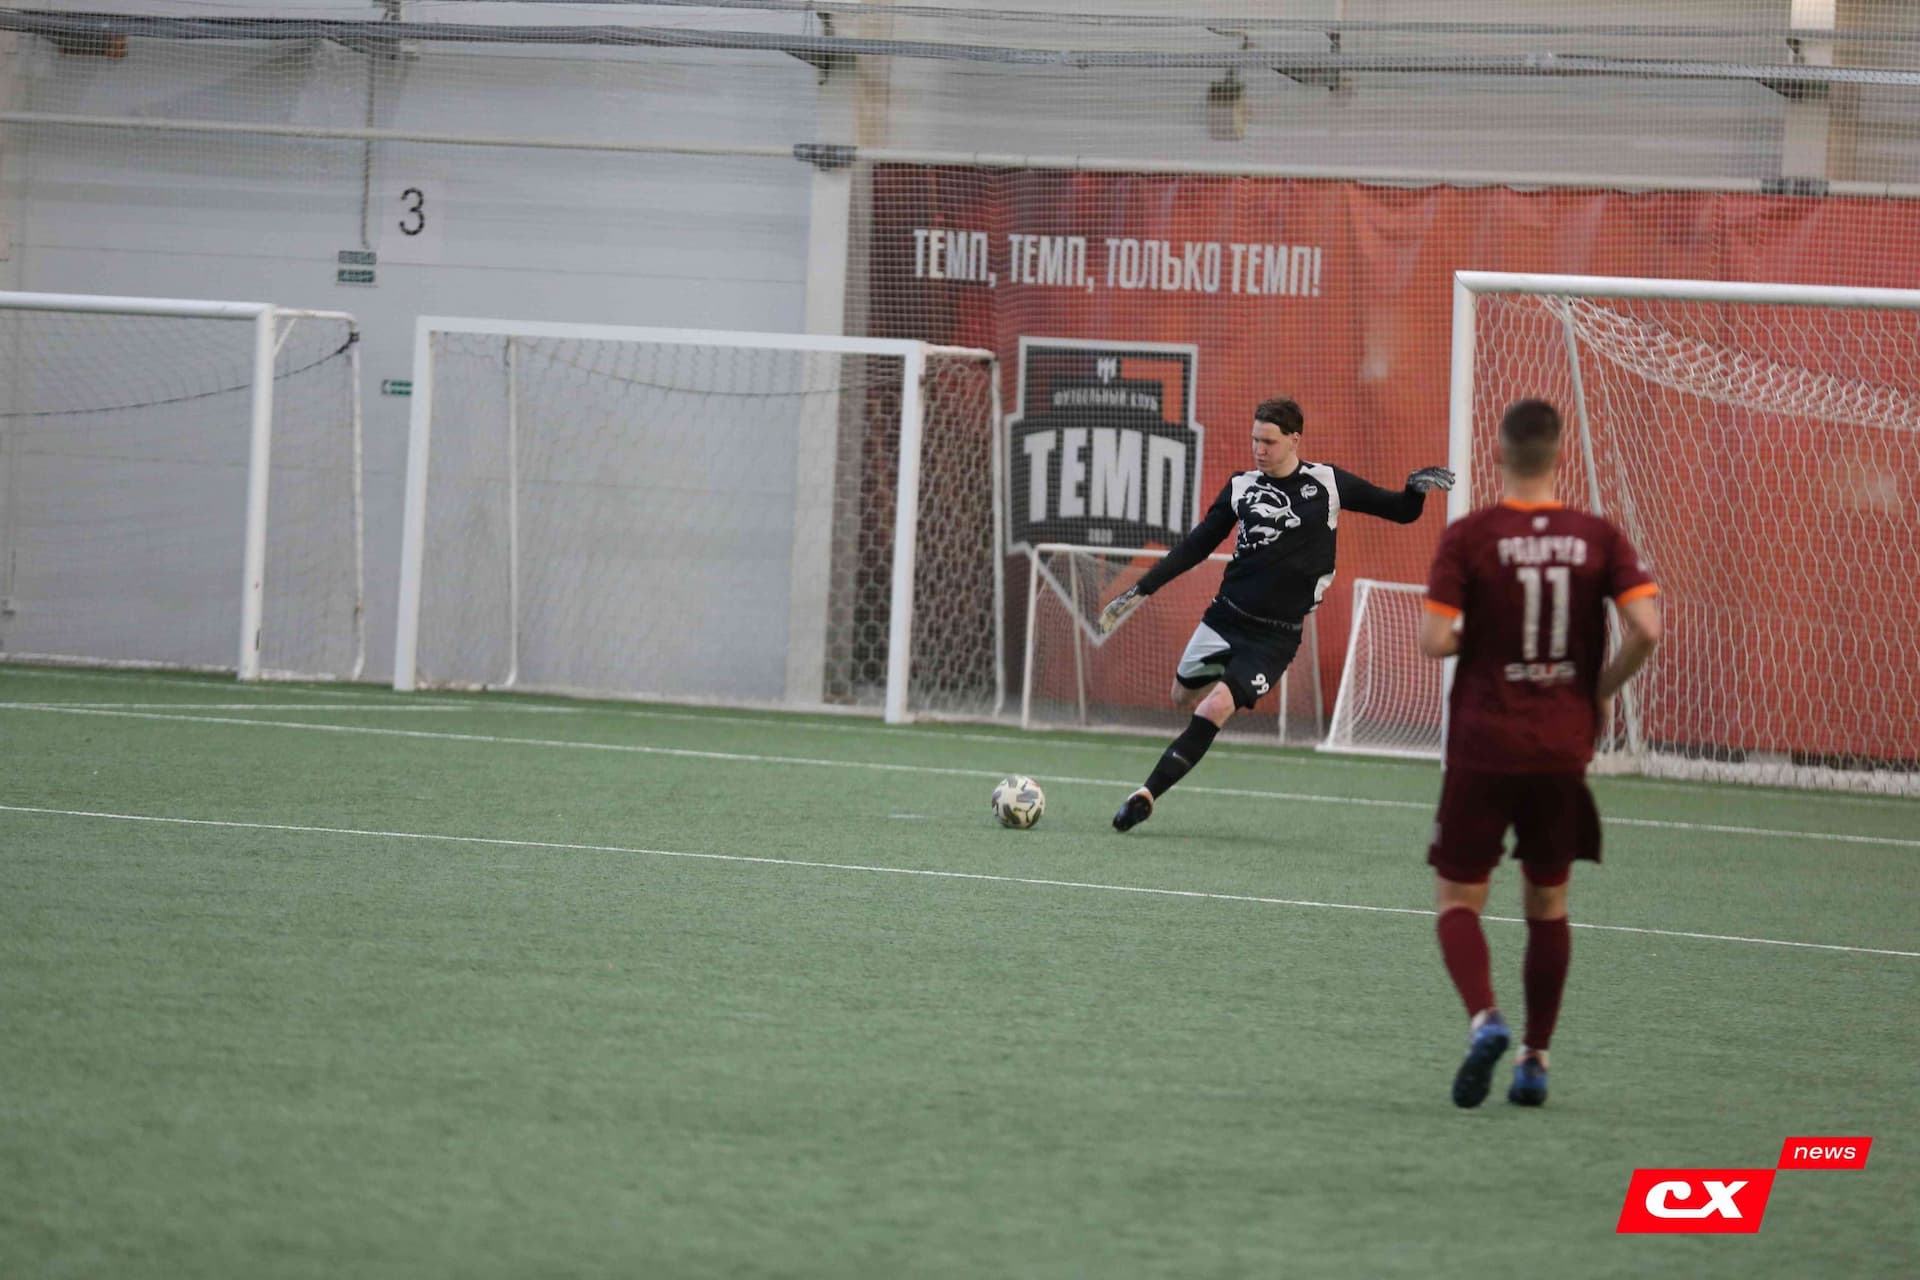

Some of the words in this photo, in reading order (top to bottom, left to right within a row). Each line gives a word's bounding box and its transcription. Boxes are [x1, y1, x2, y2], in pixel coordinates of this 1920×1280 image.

[399, 187, 425, 236] 3
[913, 228, 996, 287] ТЕМП,
[1008, 233, 1095, 292] ТЕМП,
[1105, 238, 1220, 294] ТОЛЬКО
[1230, 243, 1322, 297] ТЕМП!
[1023, 426, 1187, 534] ТЕМП
[1516, 566, 1571, 661] 11
